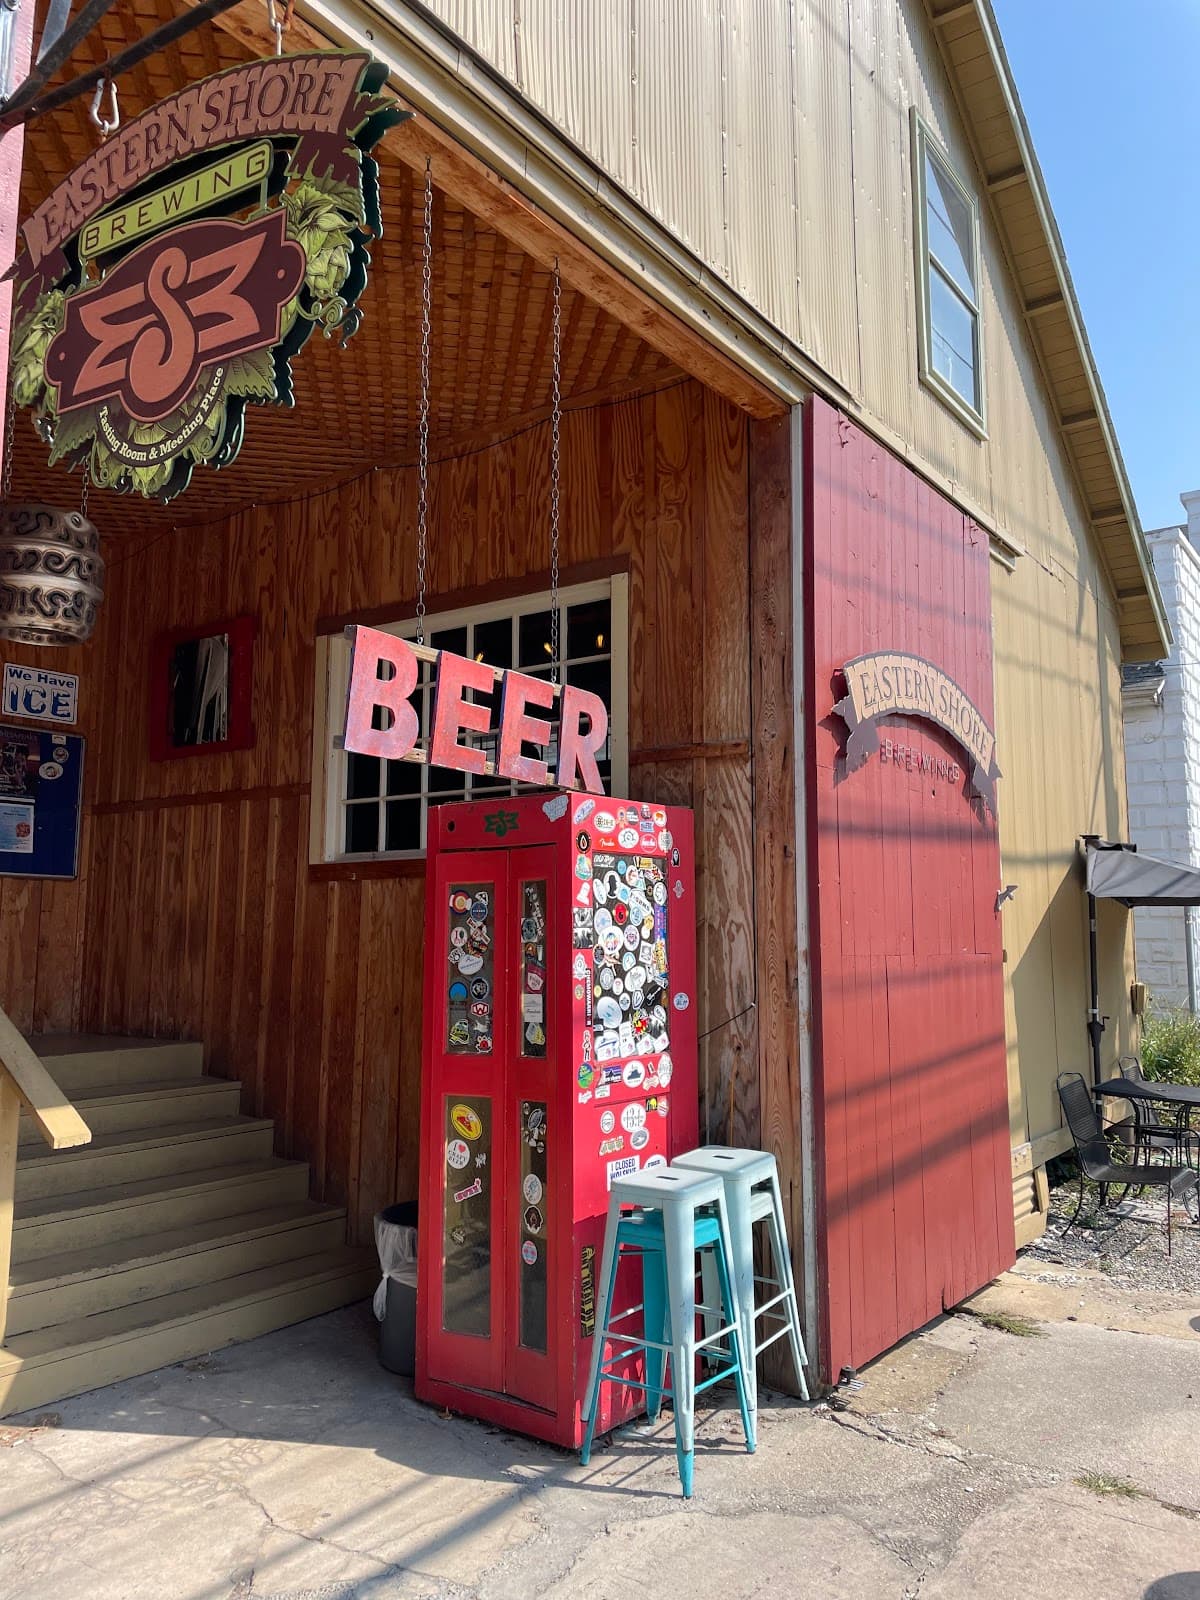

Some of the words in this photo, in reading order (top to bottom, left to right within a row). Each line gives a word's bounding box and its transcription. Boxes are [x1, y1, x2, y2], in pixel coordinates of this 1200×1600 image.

[45, 98, 193, 243] EASTERN
[200, 71, 346, 129] SHORE
[84, 152, 268, 252] BREWING
[99, 405, 121, 452] Tasting
[119, 442, 147, 461] Room
[148, 447, 159, 459] &
[159, 411, 204, 456] Meeting
[200, 367, 224, 412] Place
[8, 667, 32, 681] We
[37, 673, 75, 689] Have
[9, 683, 71, 718] ICE
[344, 624, 608, 795] BEER
[859, 666, 936, 707] EASTERN
[939, 684, 988, 759] SHORE
[884, 738, 960, 781] BREWING
[615, 1158, 636, 1171] CLOSED
